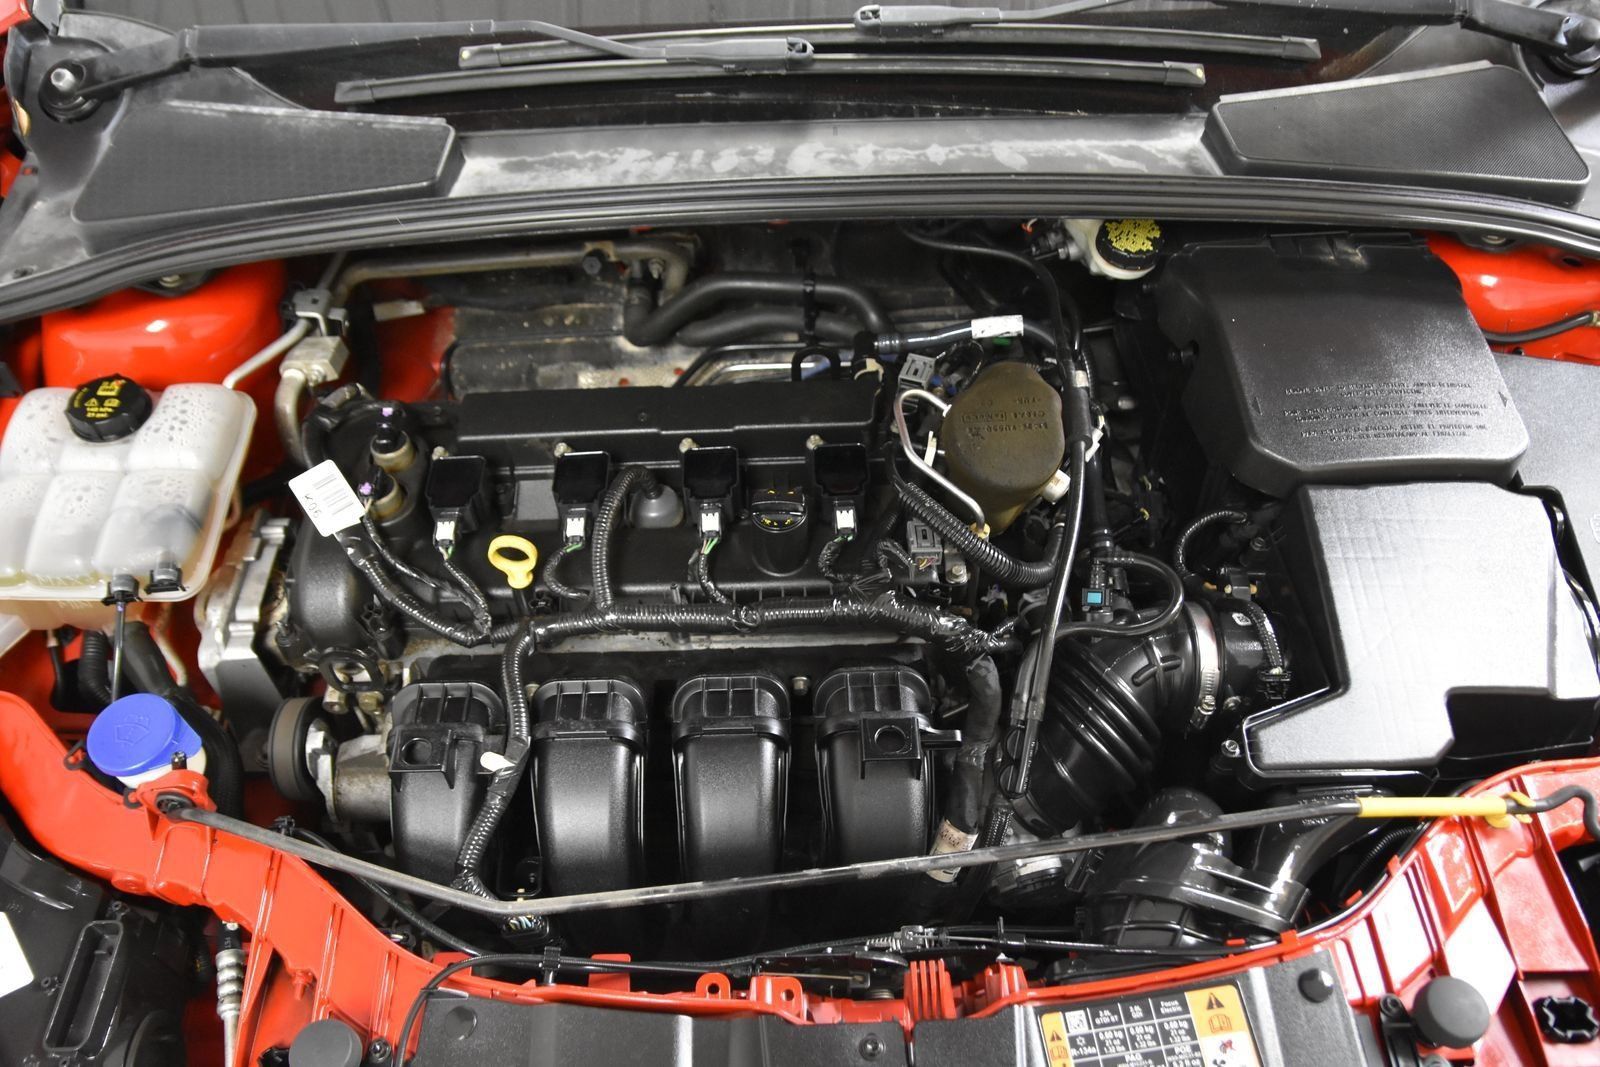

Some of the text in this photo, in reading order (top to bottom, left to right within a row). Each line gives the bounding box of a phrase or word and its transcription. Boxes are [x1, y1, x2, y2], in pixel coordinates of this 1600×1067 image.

[1160, 1000, 1180, 1008] Focus
[1144, 1024, 1155, 1035] kg
[1178, 1019, 1189, 1030] kg
[1114, 1029, 1125, 1040] kg
